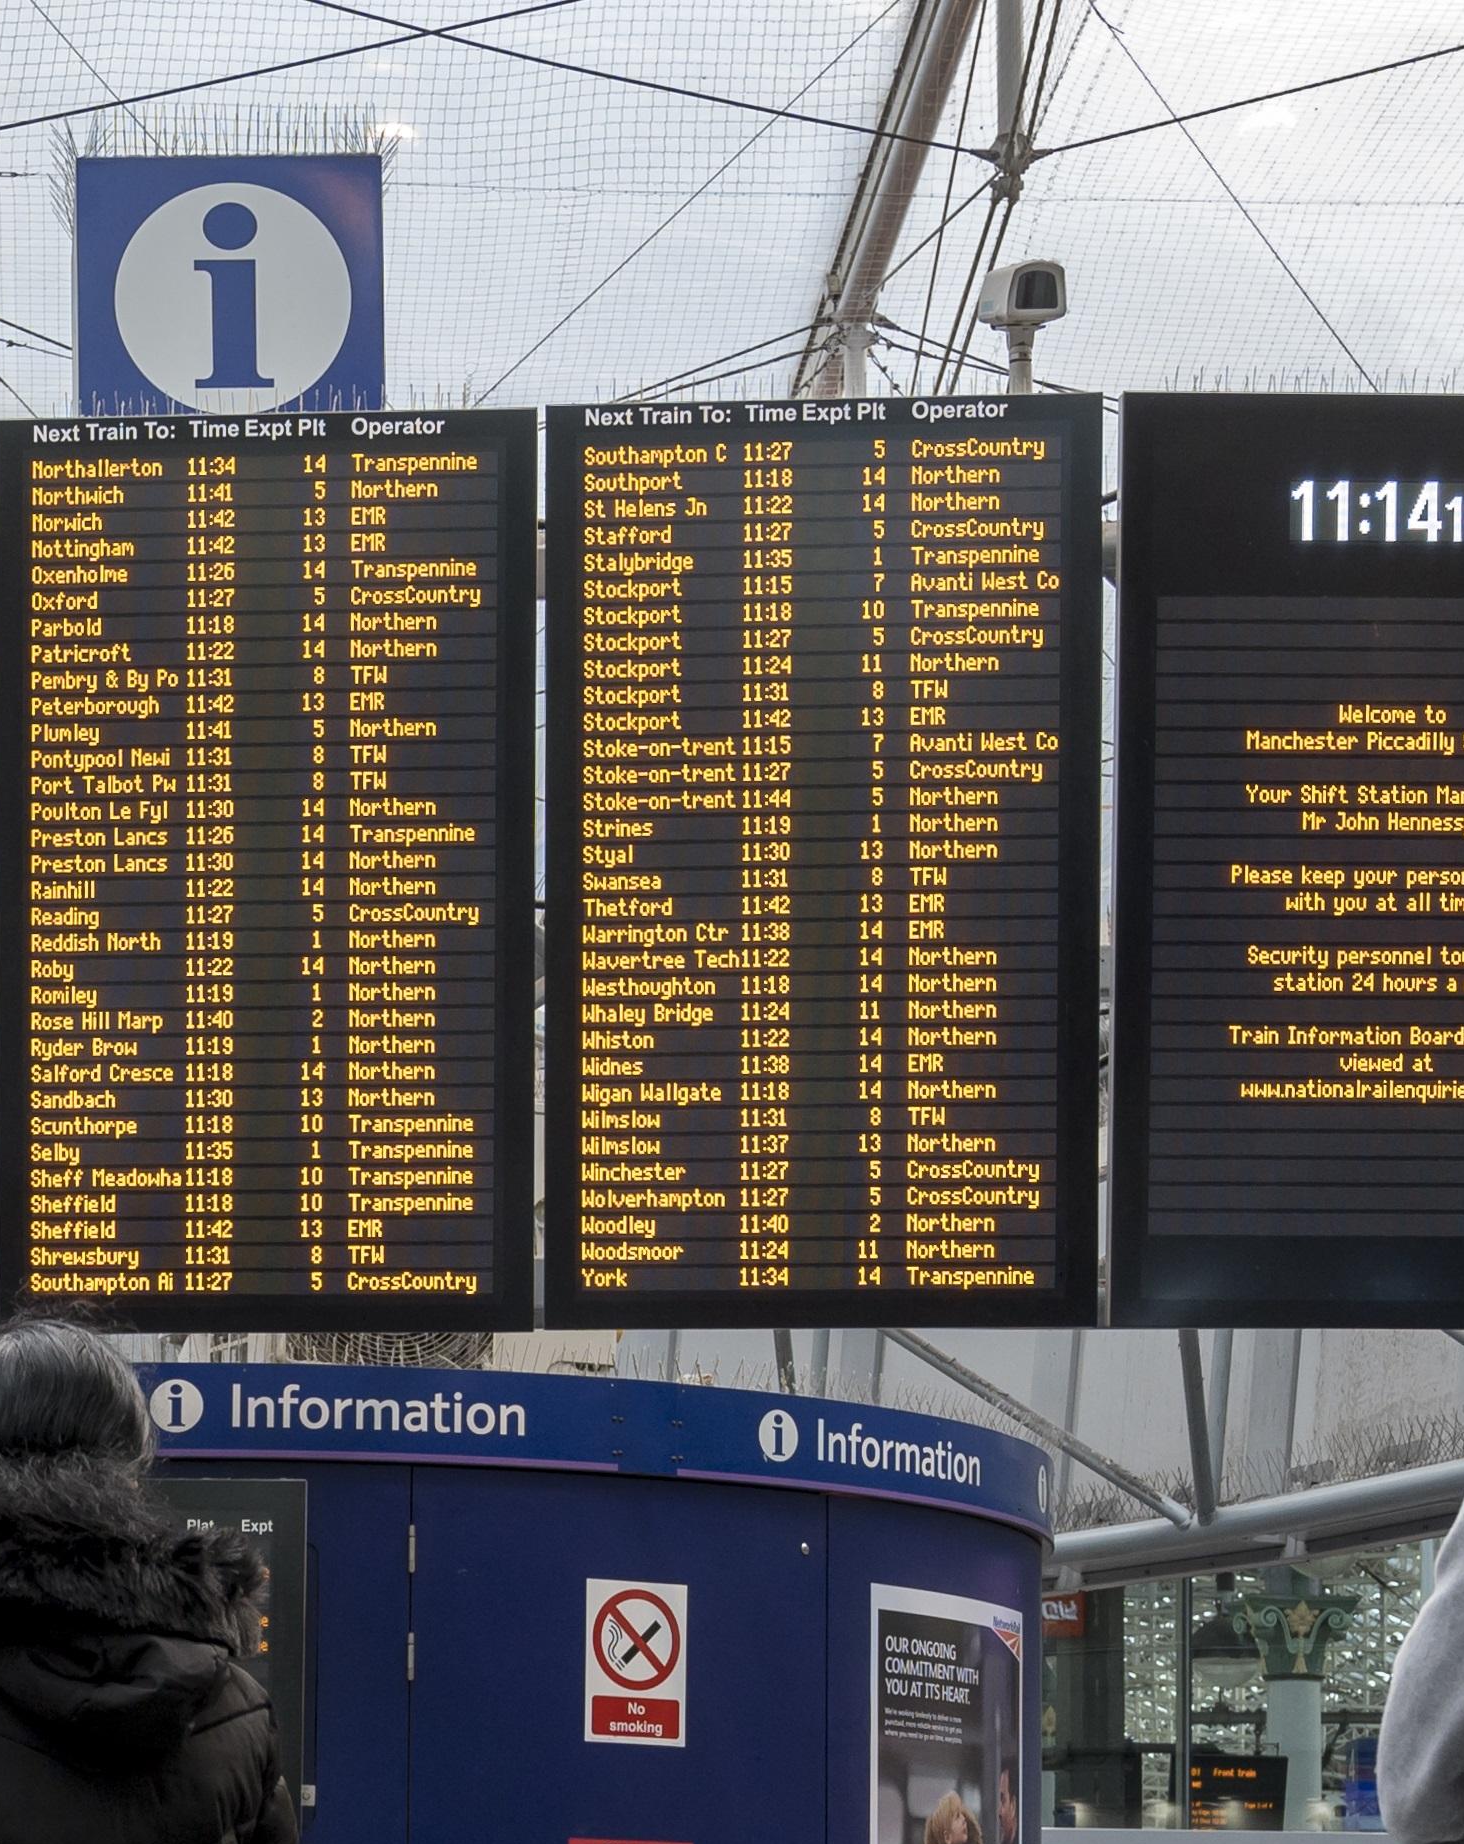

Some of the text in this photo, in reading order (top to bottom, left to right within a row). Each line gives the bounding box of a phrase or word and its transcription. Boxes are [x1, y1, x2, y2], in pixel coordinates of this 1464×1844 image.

[32, 418, 444, 442] Next Train To: Time Expt Plt Operator
[1292, 480, 1442, 542] 11:14
[583, 517, 1045, 547] Stafford 11:27 5 CrossCountry
[31, 532, 386, 563] Nottingham 11:42 13 EMR
[1338, 703, 1447, 725] Welcome to
[1246, 729, 1359, 751] Manchester
[1366, 730, 1455, 756] Piccadilly
[1245, 783, 1293, 804] Your
[1300, 784, 1350, 805] Shift
[1357, 784, 1429, 805] Station
[1301, 810, 1327, 831] Mr
[1334, 810, 1380, 832] John
[232, 1384, 526, 1436] Information
[818, 1418, 981, 1486] Information
[241, 1519, 274, 1535] Expt
[885, 1635, 956, 1660] OUR ONGOING
[885, 1657, 978, 1686] COMMITMENT WITH
[885, 1678, 970, 1704] YOU AT ITS HEART.
[628, 1702, 646, 1715] No
[610, 1720, 662, 1736] smoking
